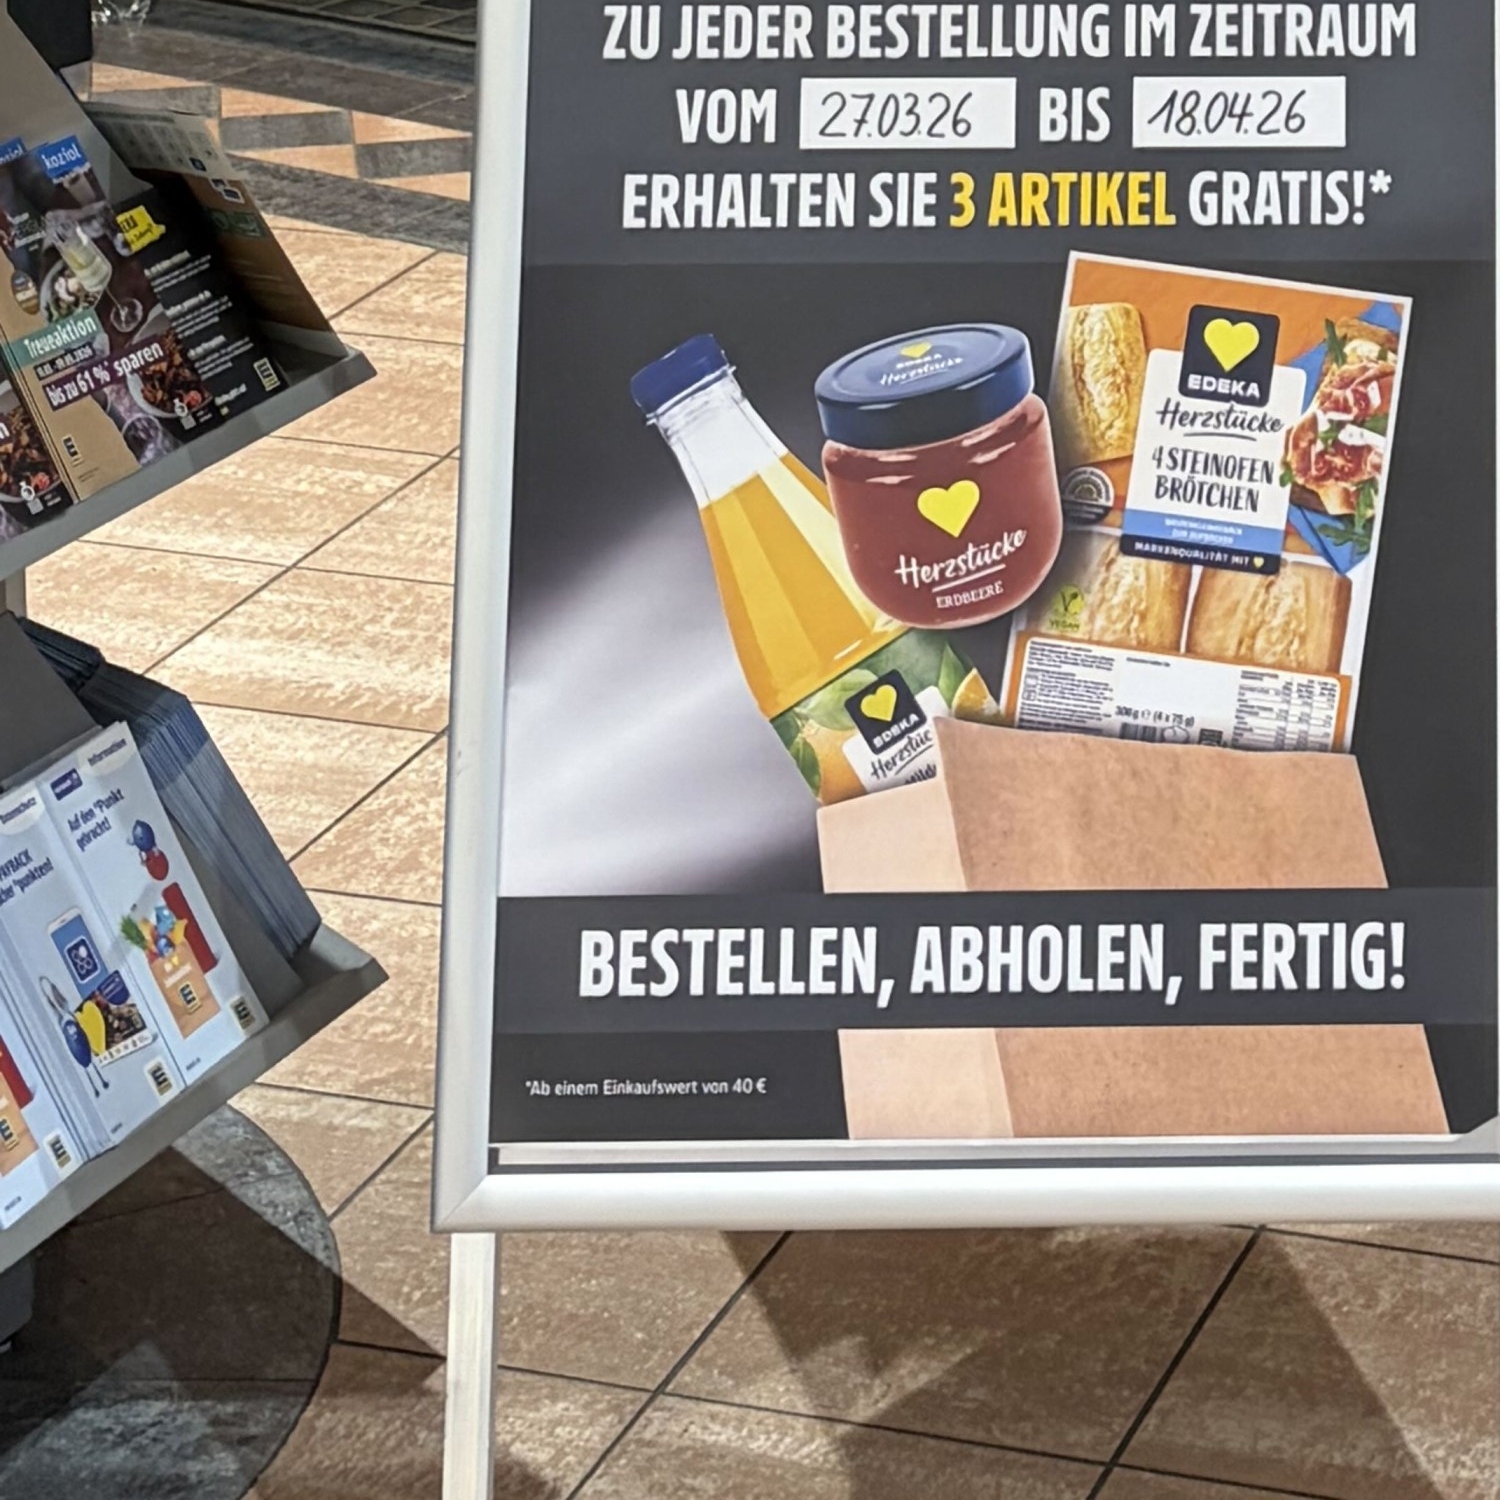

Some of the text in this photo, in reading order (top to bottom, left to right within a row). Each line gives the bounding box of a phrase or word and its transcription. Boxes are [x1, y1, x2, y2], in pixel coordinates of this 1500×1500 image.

[602, 3, 1417, 60] ZU JEDER BESTELLUNG IM ZEITRAUM
[675, 88, 777, 145] VOM
[818, 90, 974, 139] 27.03.26
[1038, 86, 1112, 143] BIS
[1147, 89, 1308, 137] 18.04.26
[0, 144, 24, 165] oziol
[41, 142, 83, 170] koziol
[622, 173, 856, 229] ERHALTEN
[867, 172, 938, 228] SIE
[949, 171, 977, 228] 3
[987, 171, 1178, 227] ARTIKEL
[24, 315, 97, 359] Treueaktion
[76, 368, 95, 394] 61
[113, 341, 164, 377] sparen
[1187, 373, 1261, 399] EDEKA
[1155, 397, 1284, 434] Herzstücke
[1152, 446, 1274, 485] 4 STEINOFEN
[1154, 474, 1260, 513] BRÖTCHEN
[894, 529, 1027, 588] Herzstücke
[936, 581, 1004, 609] ERDBEERE
[872, 712, 920, 750] EDEKA
[871, 729, 934, 781] Herzstüc
[579, 921, 1406, 1009] BESTELLEN, ABHOLEN, FERTIG!
[554, 1081, 599, 1096] einem
[603, 1078, 698, 1096] Einkaufswert
[701, 1080, 729, 1094] von
[732, 1077, 753, 1094] 40
[756, 1077, 767, 1094] €
